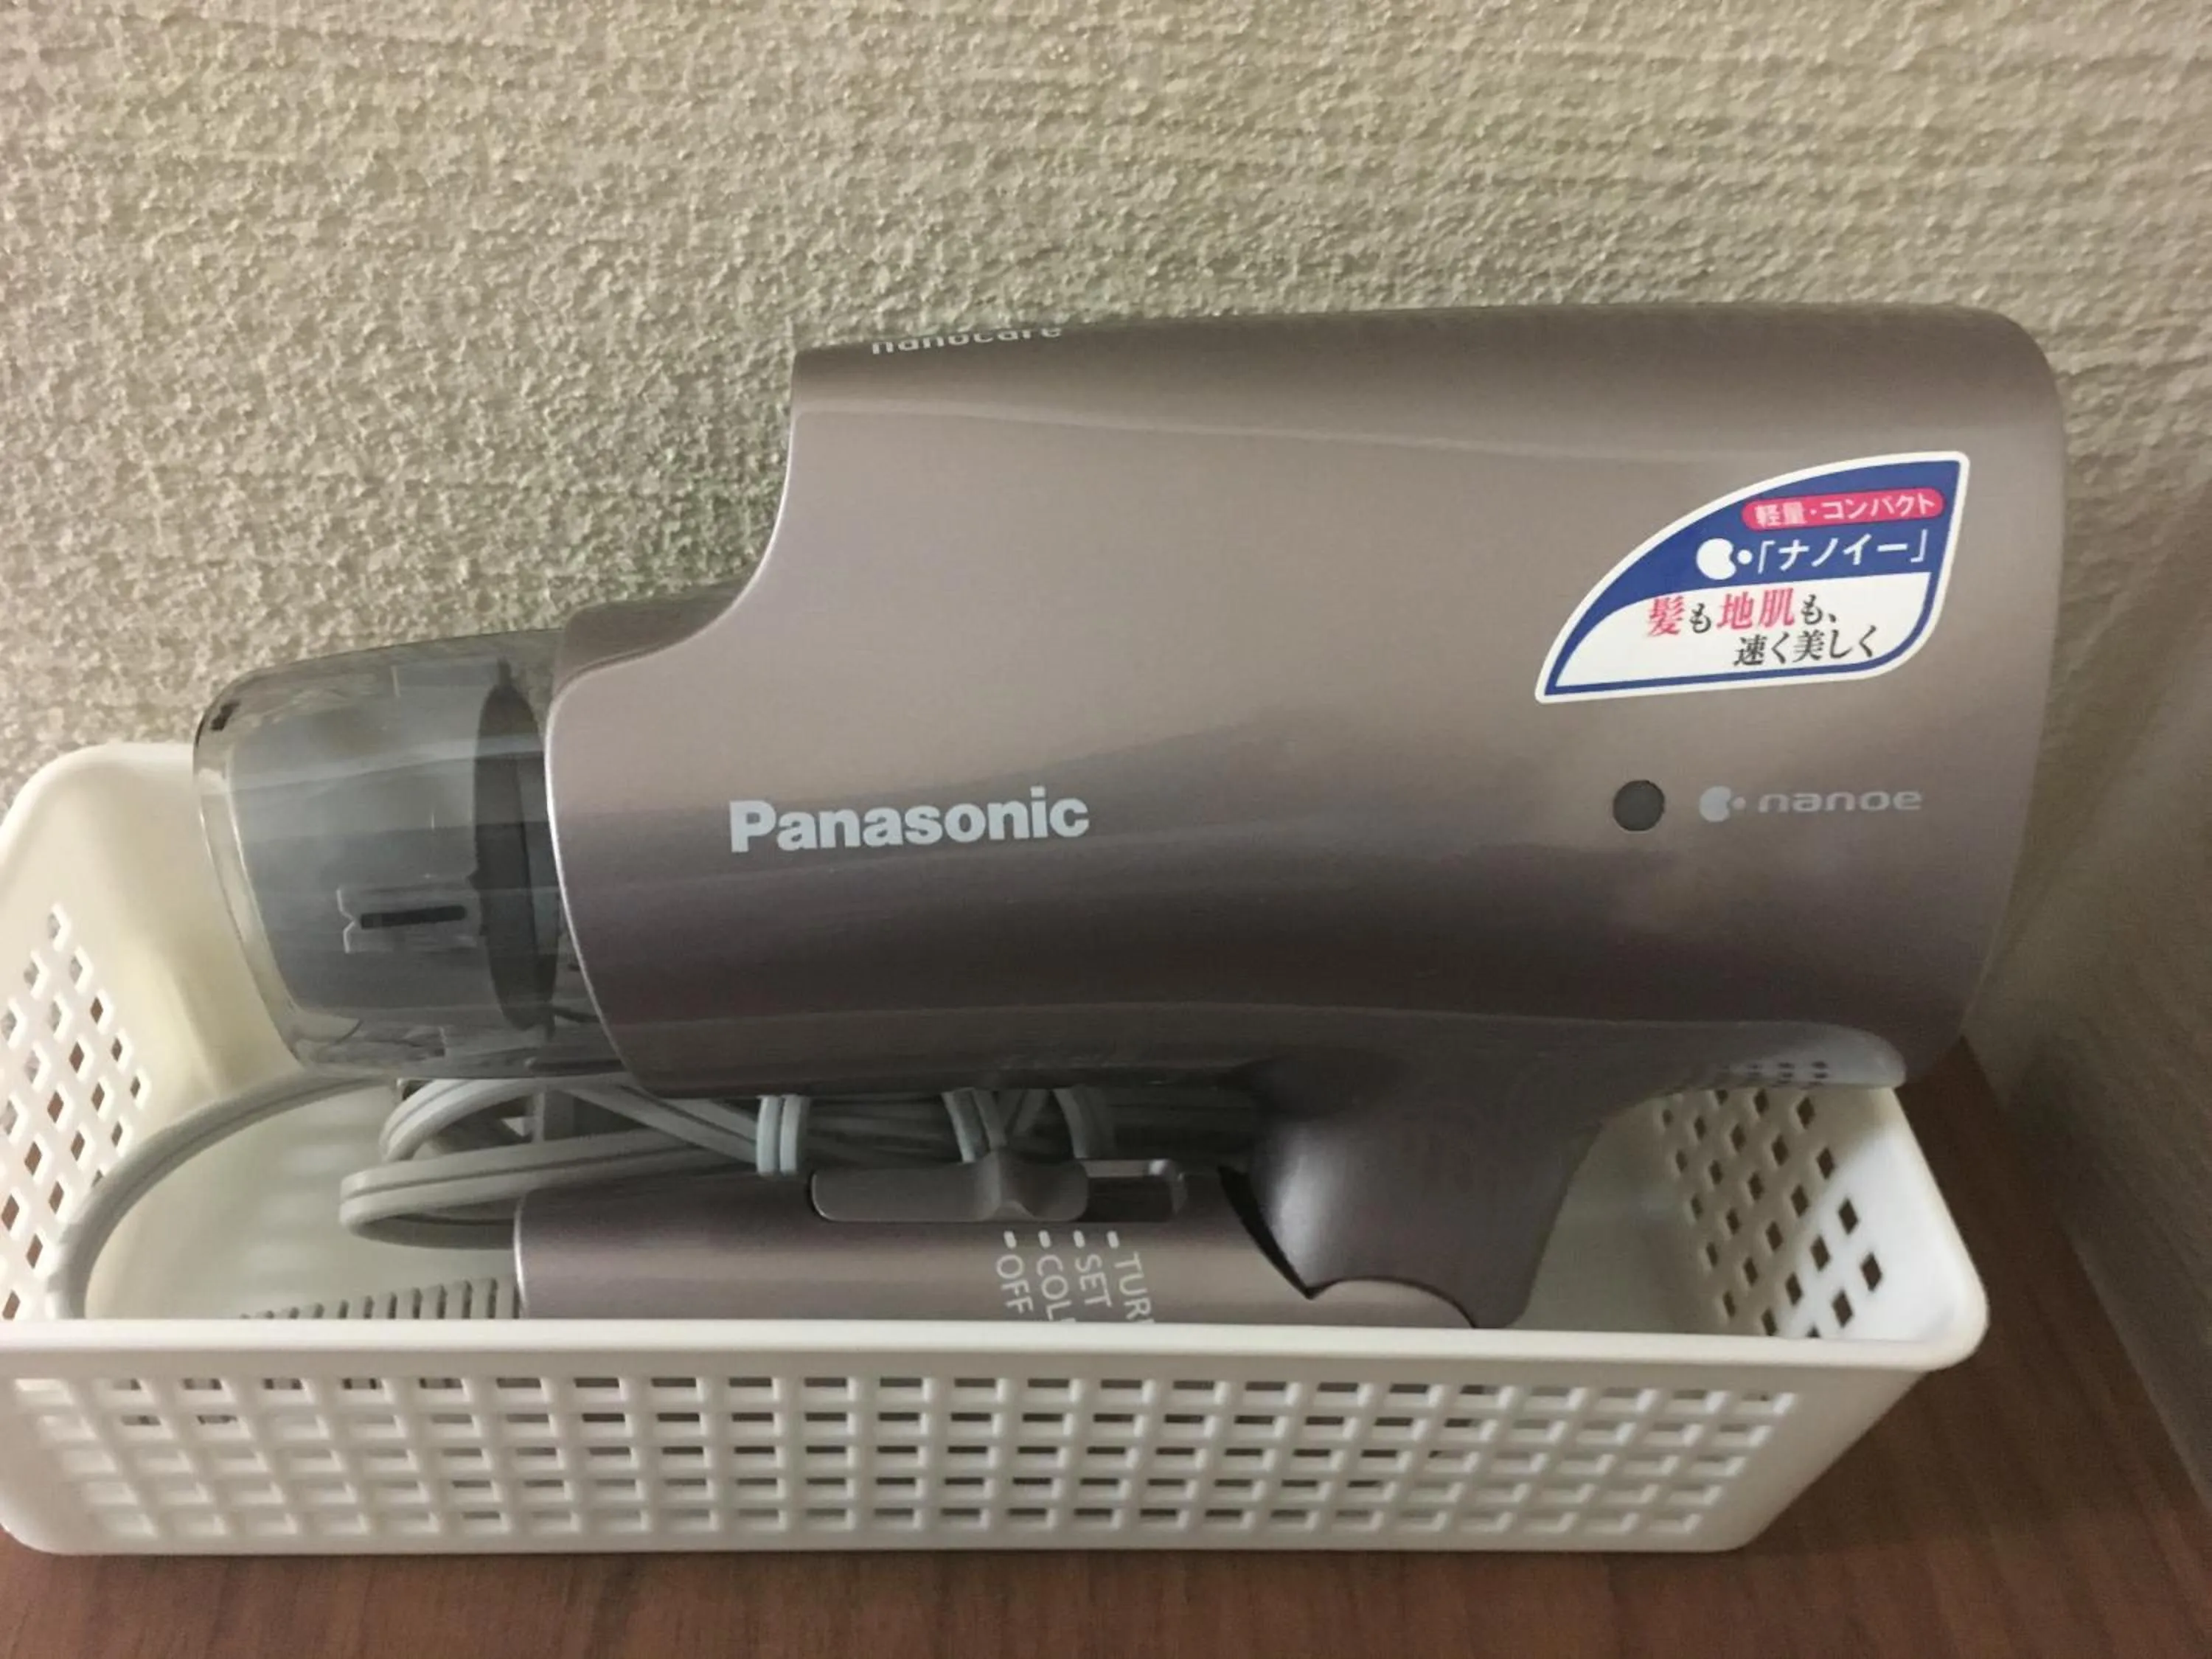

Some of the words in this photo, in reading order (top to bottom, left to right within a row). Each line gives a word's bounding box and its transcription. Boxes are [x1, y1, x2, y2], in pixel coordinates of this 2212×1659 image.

[1757, 530, 1929, 574] 「ナノイー」
[1648, 588, 1837, 636] 髪も地肌も、
[1733, 625, 1876, 666] 速く美しく
[730, 786, 1089, 852] Panasonic
[1759, 790, 1922, 813] nanoe
[995, 1254, 1033, 1313] OFF
[1036, 1255, 1077, 1321] COL
[1074, 1254, 1112, 1307] SET
[1114, 1251, 1155, 1324] TUR
